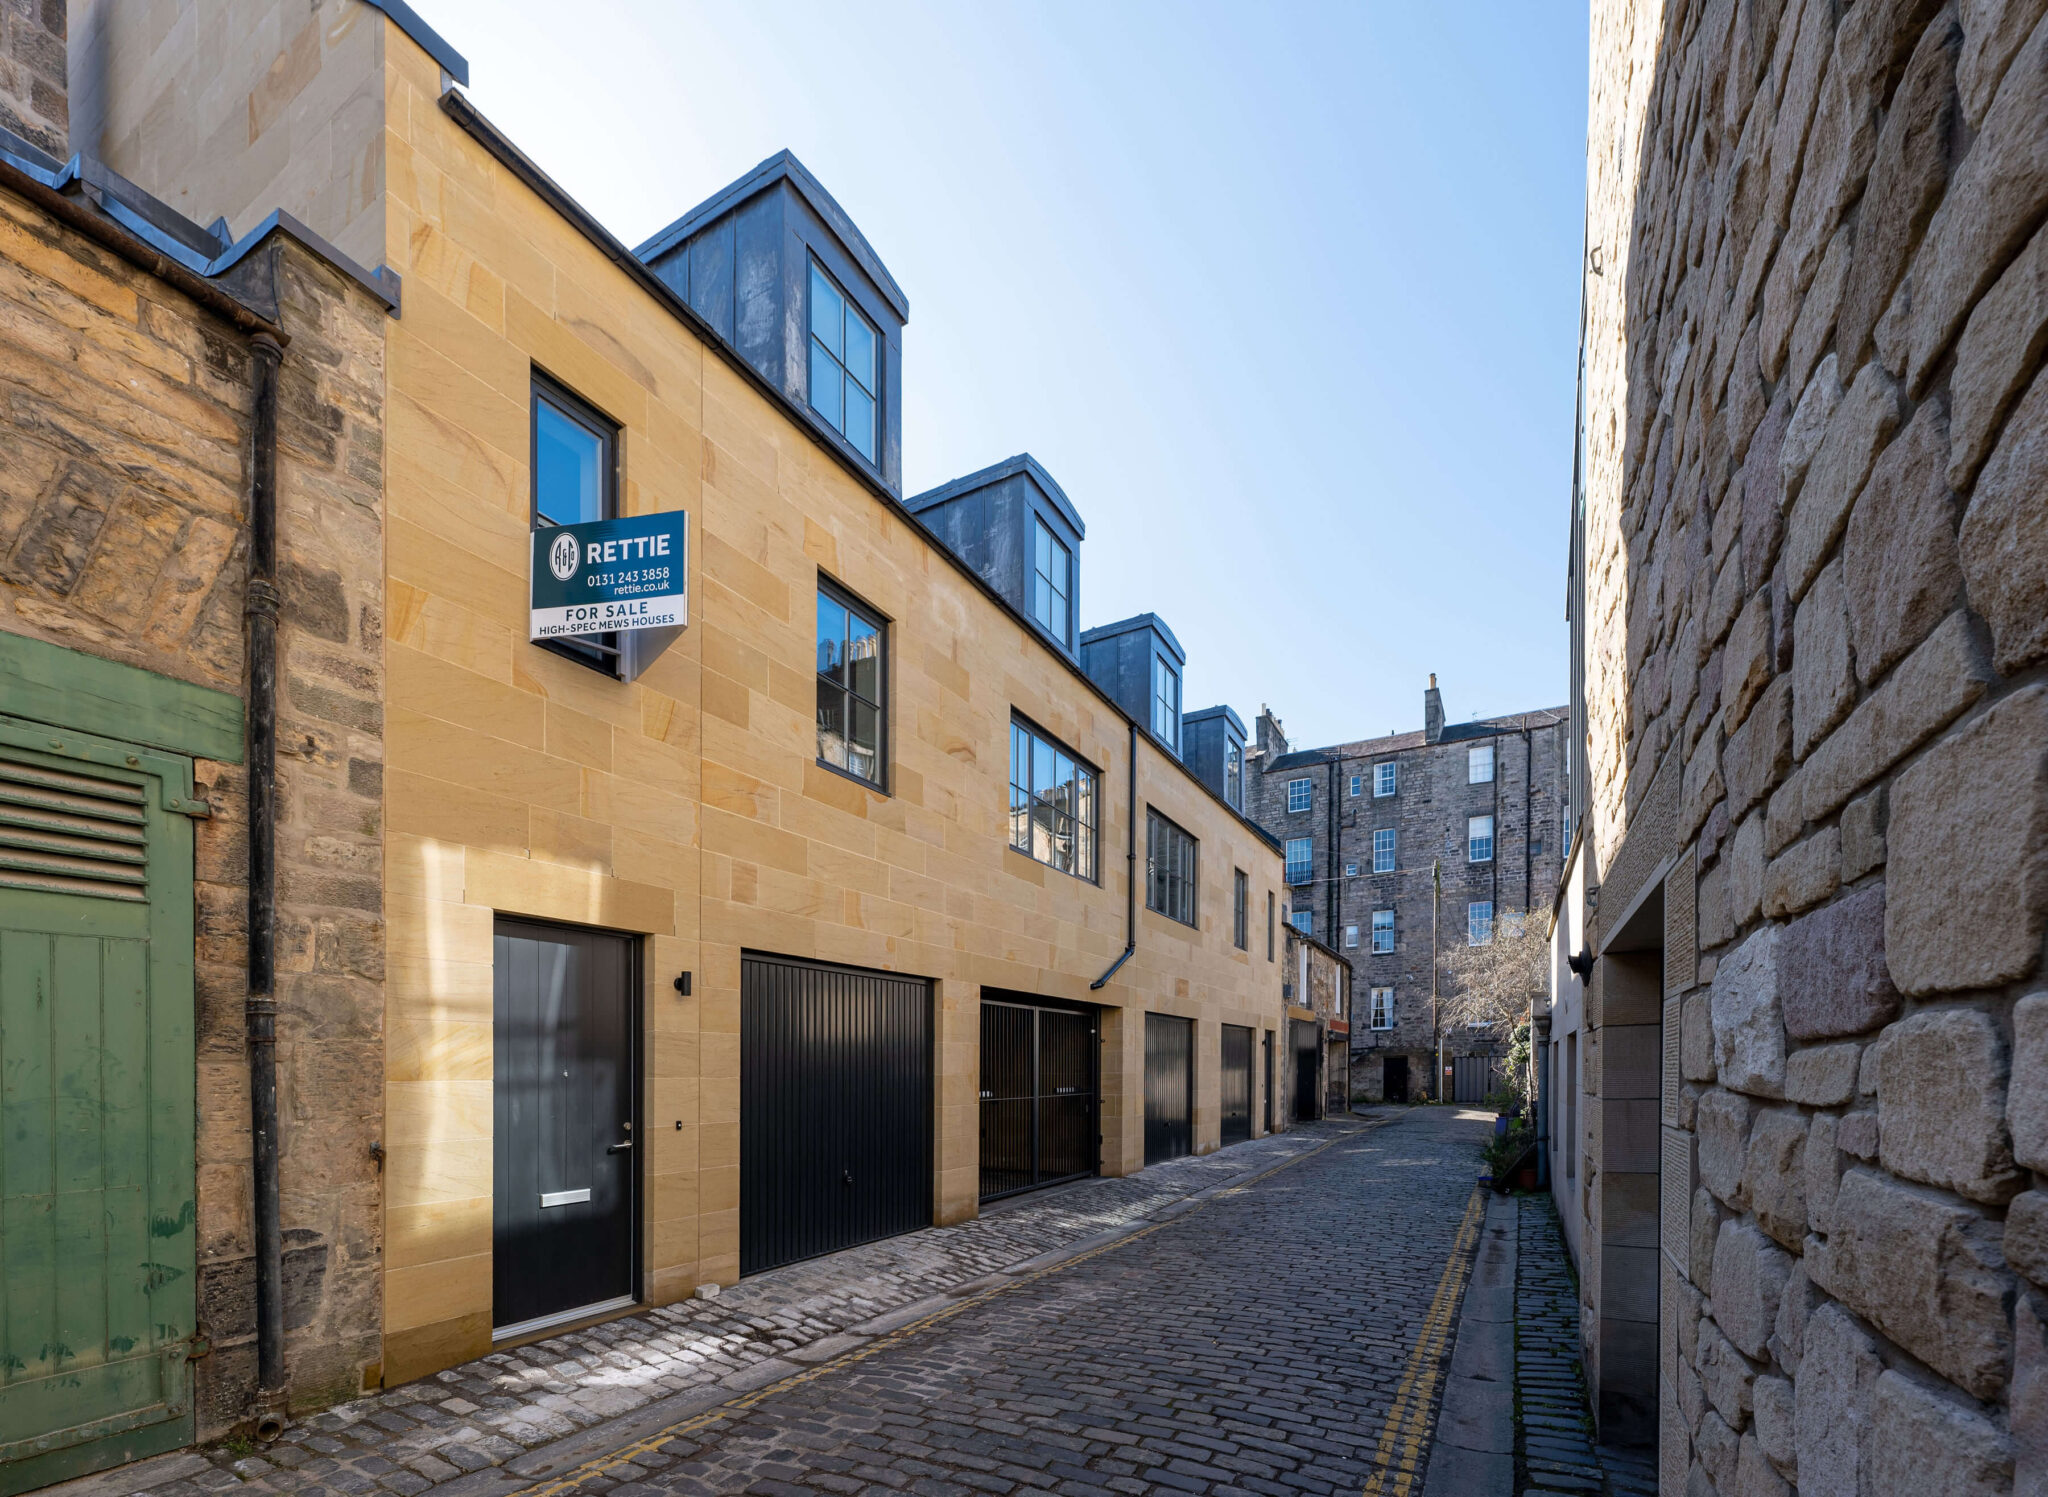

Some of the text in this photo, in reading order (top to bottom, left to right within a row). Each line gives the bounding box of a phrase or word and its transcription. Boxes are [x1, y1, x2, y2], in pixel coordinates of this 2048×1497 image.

[587, 534, 671, 564] RETTIE
[588, 567, 670, 587] 0131 243 3858
[614, 579, 670, 595] rettie.co.uk
[566, 602, 648, 621] FOR SALE
[539, 614, 675, 636] HIGH-SPEC MEWS HOUSES
